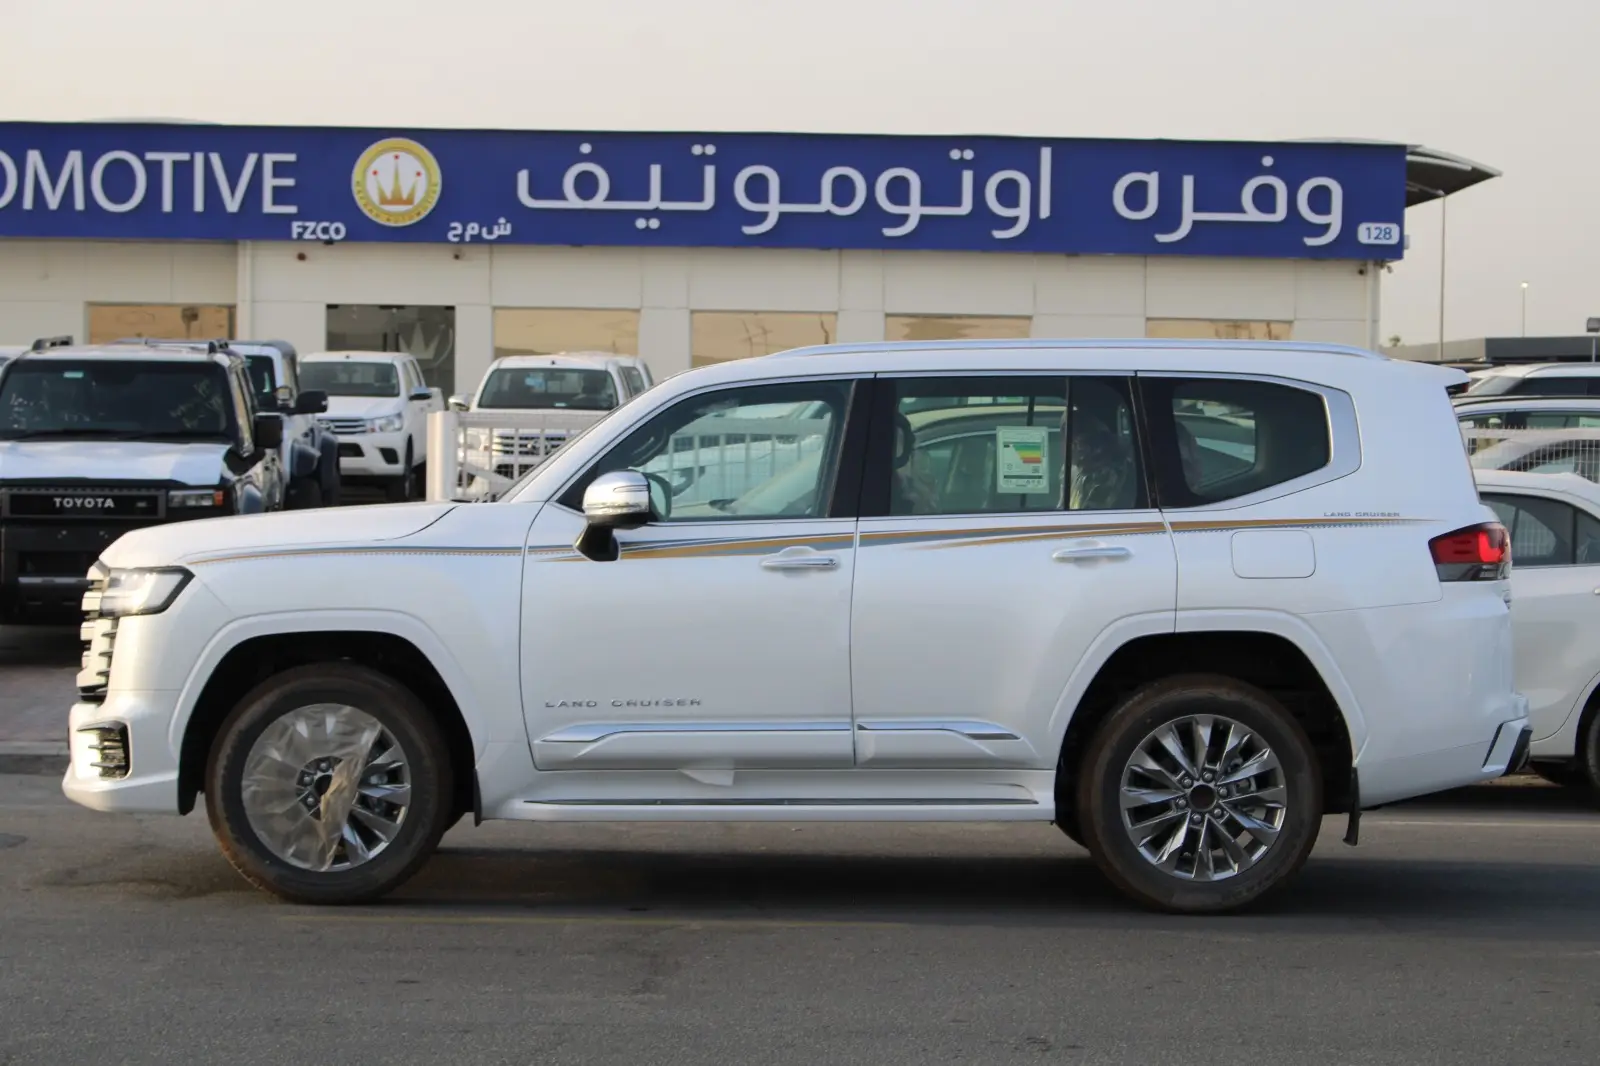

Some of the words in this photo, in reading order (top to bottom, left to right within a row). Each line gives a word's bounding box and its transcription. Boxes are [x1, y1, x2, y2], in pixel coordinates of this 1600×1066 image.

[517, 142, 1052, 239] اوتوموتيف
[1112, 155, 1343, 246] وفره
[291, 221, 346, 240] FZCO
[1365, 226, 1392, 240] 128
[53, 497, 115, 508] TOYOTA
[545, 699, 598, 708] LAND
[611, 698, 702, 708] CRUISER
